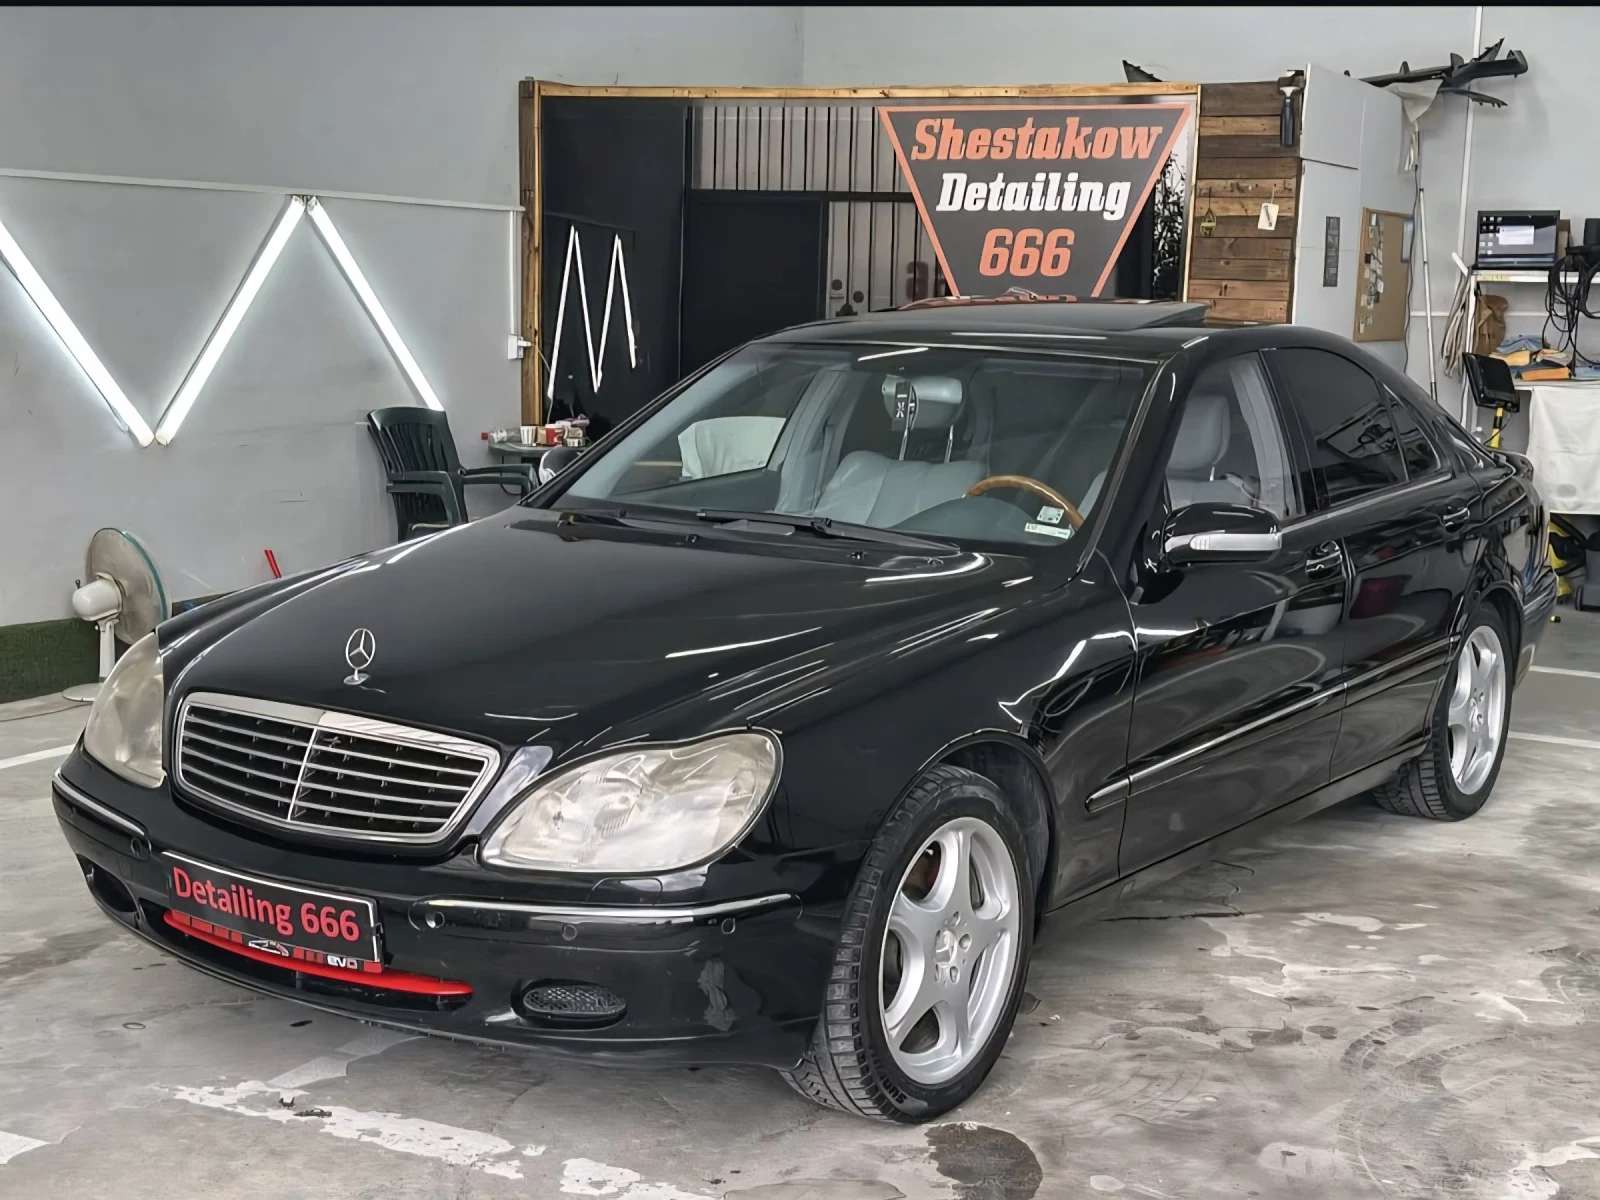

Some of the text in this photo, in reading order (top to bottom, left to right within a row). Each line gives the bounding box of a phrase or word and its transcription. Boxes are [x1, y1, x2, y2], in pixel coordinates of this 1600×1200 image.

[911, 116, 1163, 161] Shestakow
[935, 172, 1131, 221] Detailing
[978, 228, 1076, 277] 666
[172, 866, 361, 942] Detailing 666
